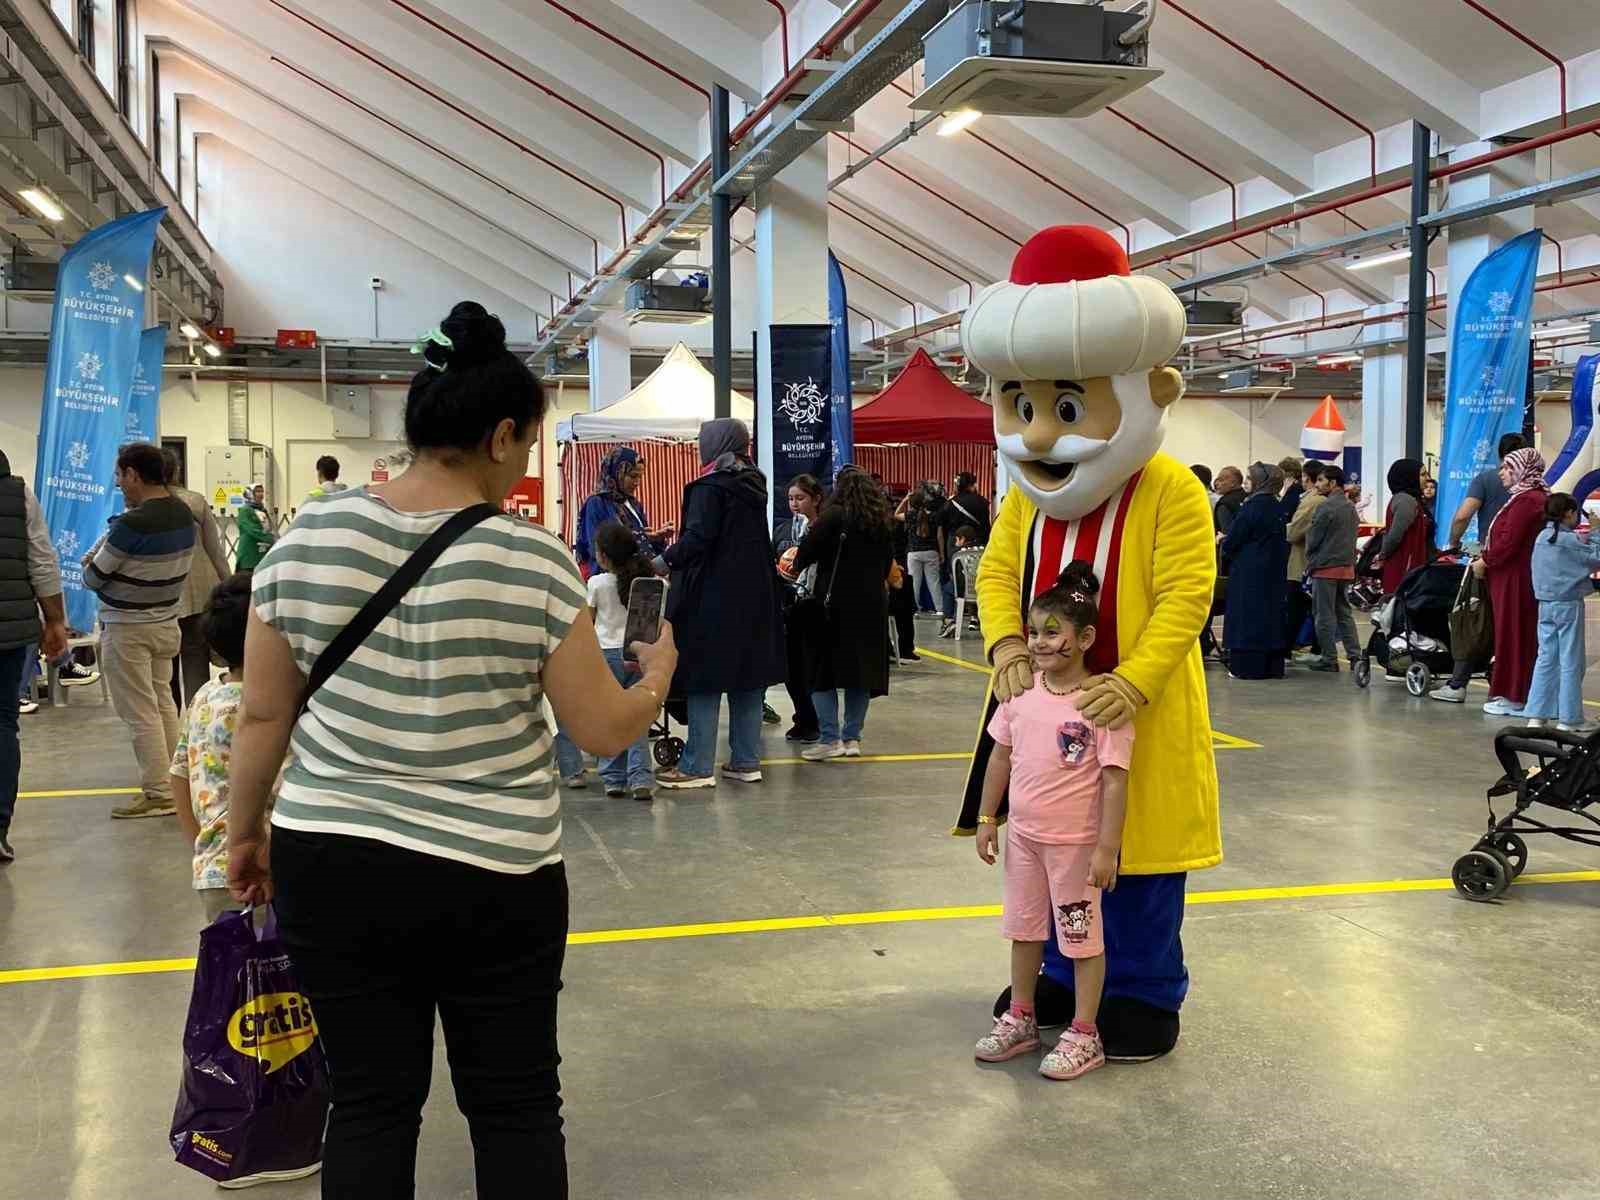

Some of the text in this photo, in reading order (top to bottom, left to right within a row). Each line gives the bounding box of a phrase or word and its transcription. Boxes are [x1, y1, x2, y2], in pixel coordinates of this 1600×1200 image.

[64, 296, 135, 319] BÜYÜKŞEHİR
[55, 386, 120, 408] BÜYÜKŞEHİR
[781, 441, 826, 453] BÜYÜKŞEHİR
[46, 475, 105, 497] BÜYÜKŞEHİR
